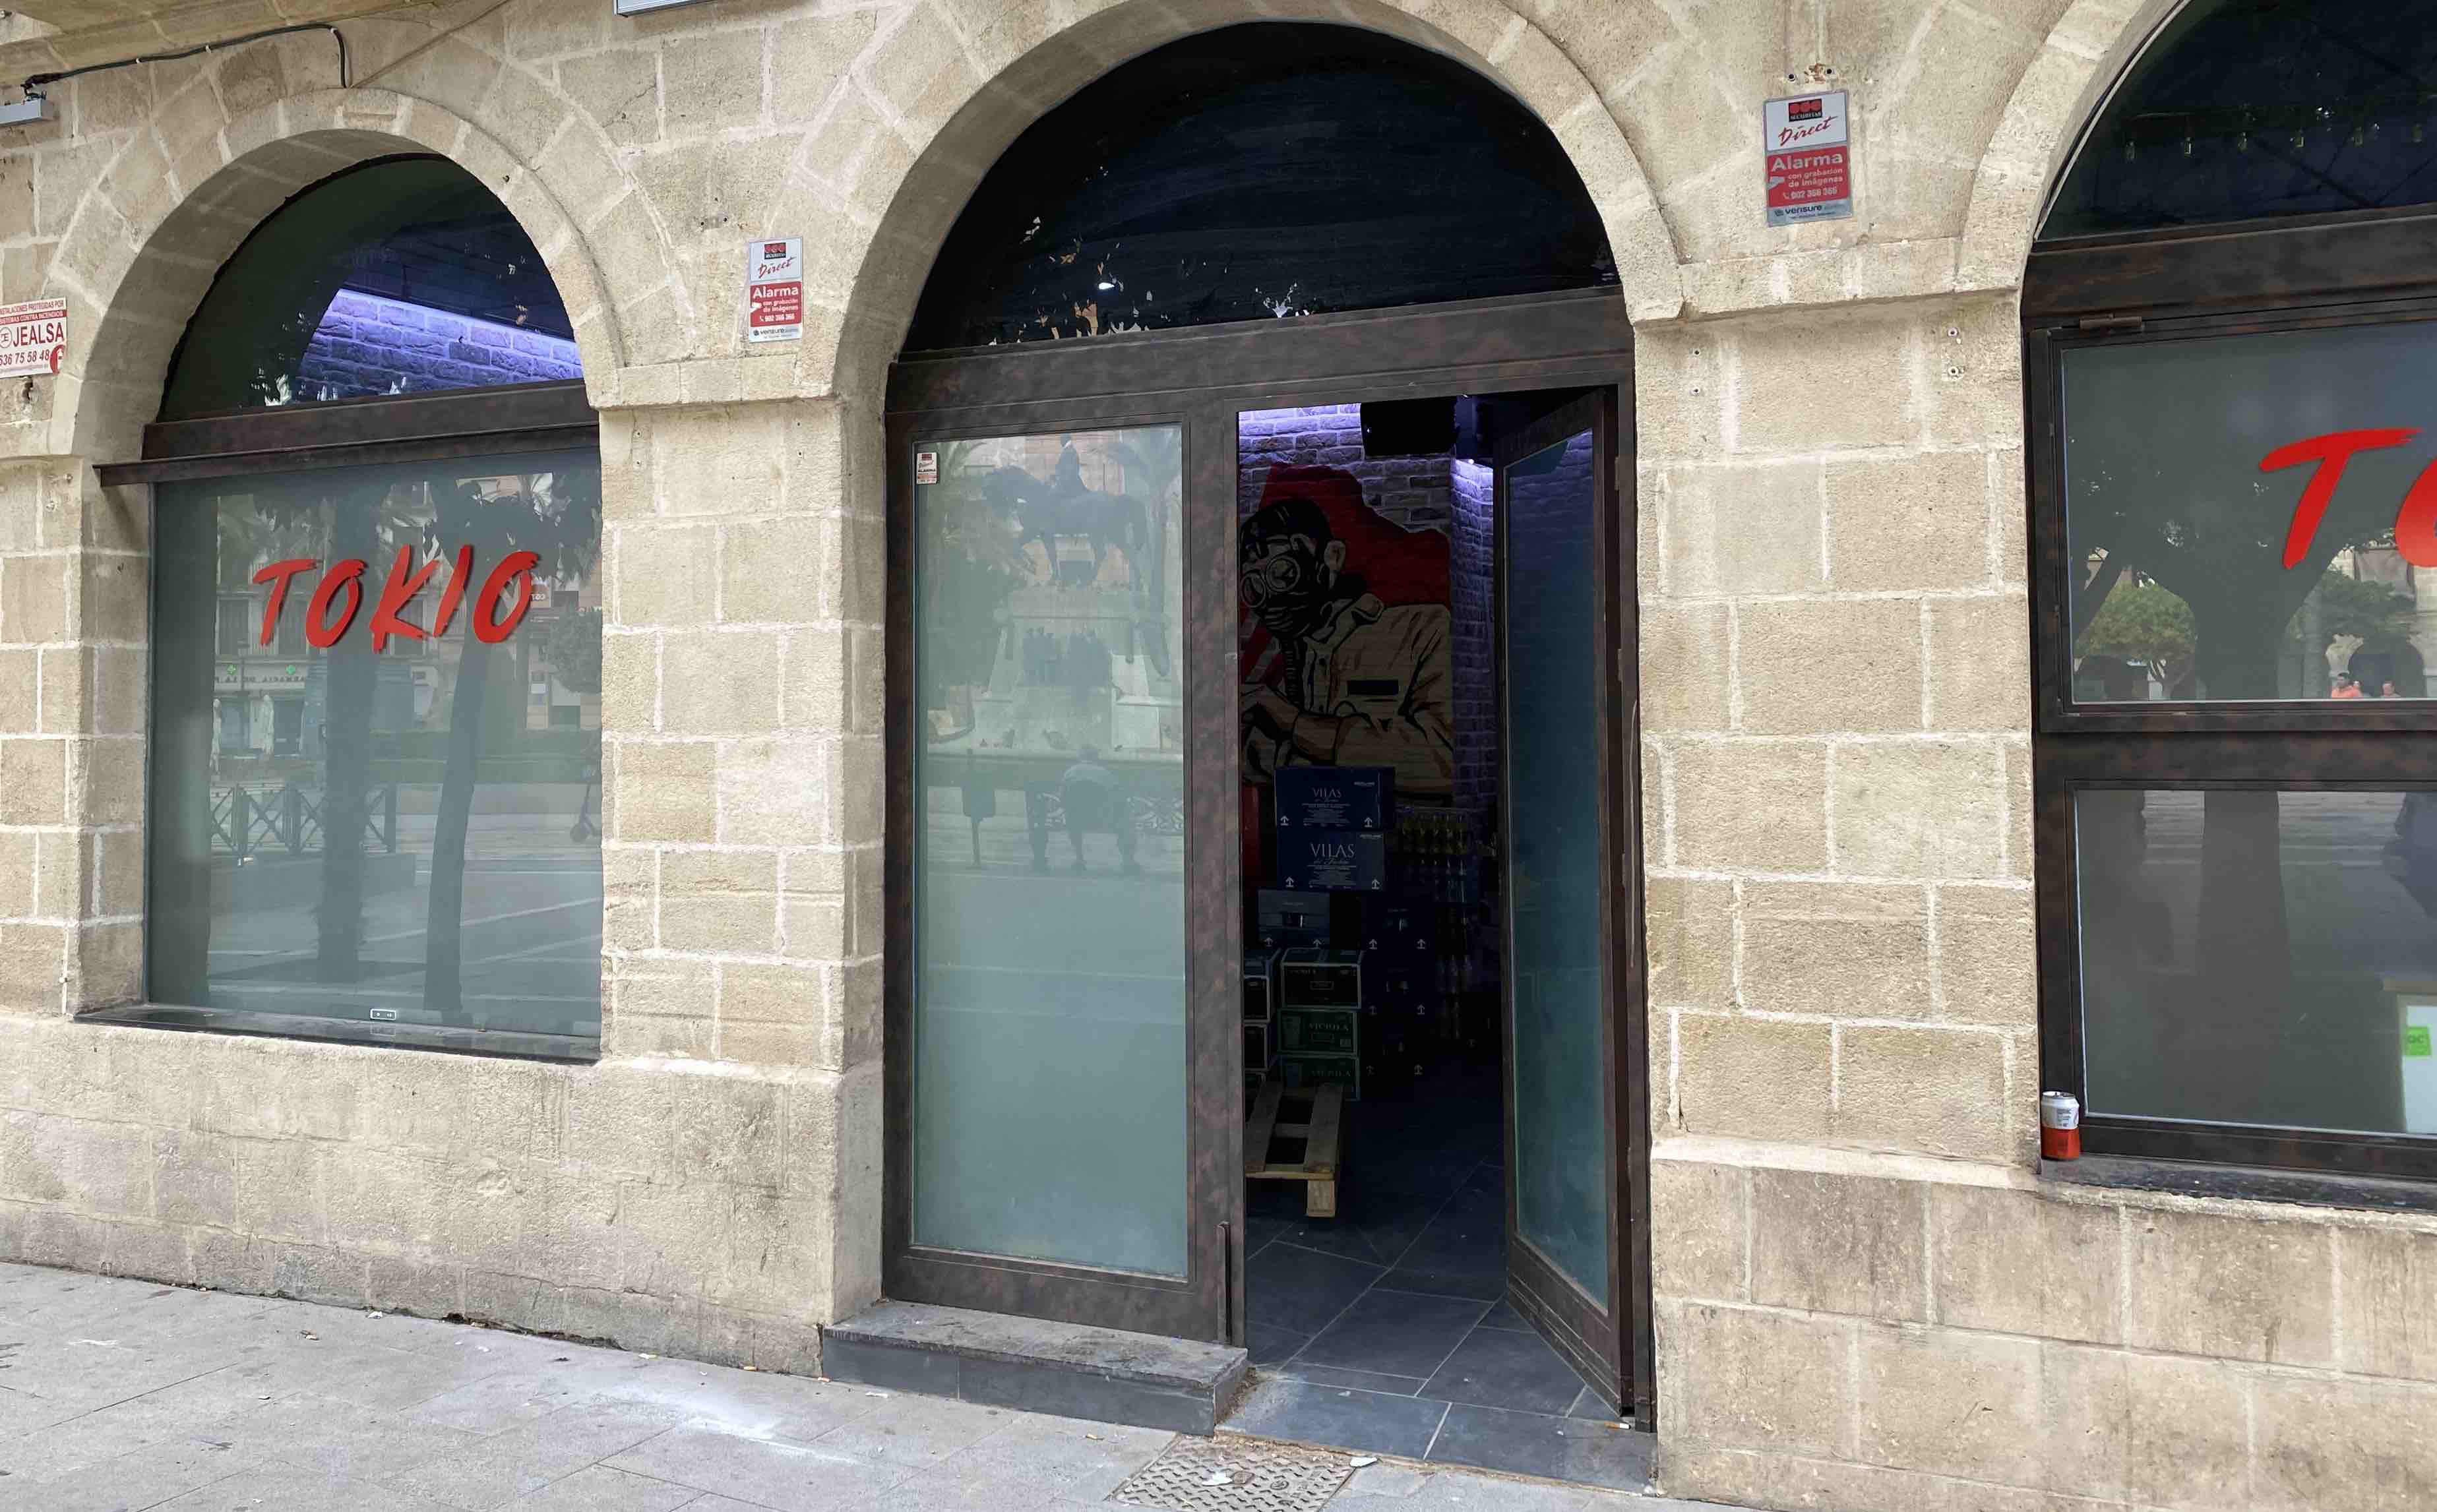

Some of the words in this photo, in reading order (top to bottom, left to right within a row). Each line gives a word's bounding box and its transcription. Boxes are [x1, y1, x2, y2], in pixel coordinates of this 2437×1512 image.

[1778, 116, 1838, 146] Direct
[1771, 153, 1843, 171] Alarma
[757, 256, 797, 278] Direct
[753, 286, 799, 299] Alarma
[13, 322, 65, 347] JEALSA
[15, 351, 25, 364] 75
[27, 350, 38, 363] 58
[40, 349, 50, 361] 48
[2259, 427, 2437, 570] T
[253, 543, 542, 653] TOKIO
[1310, 843, 1356, 859] VILAS
